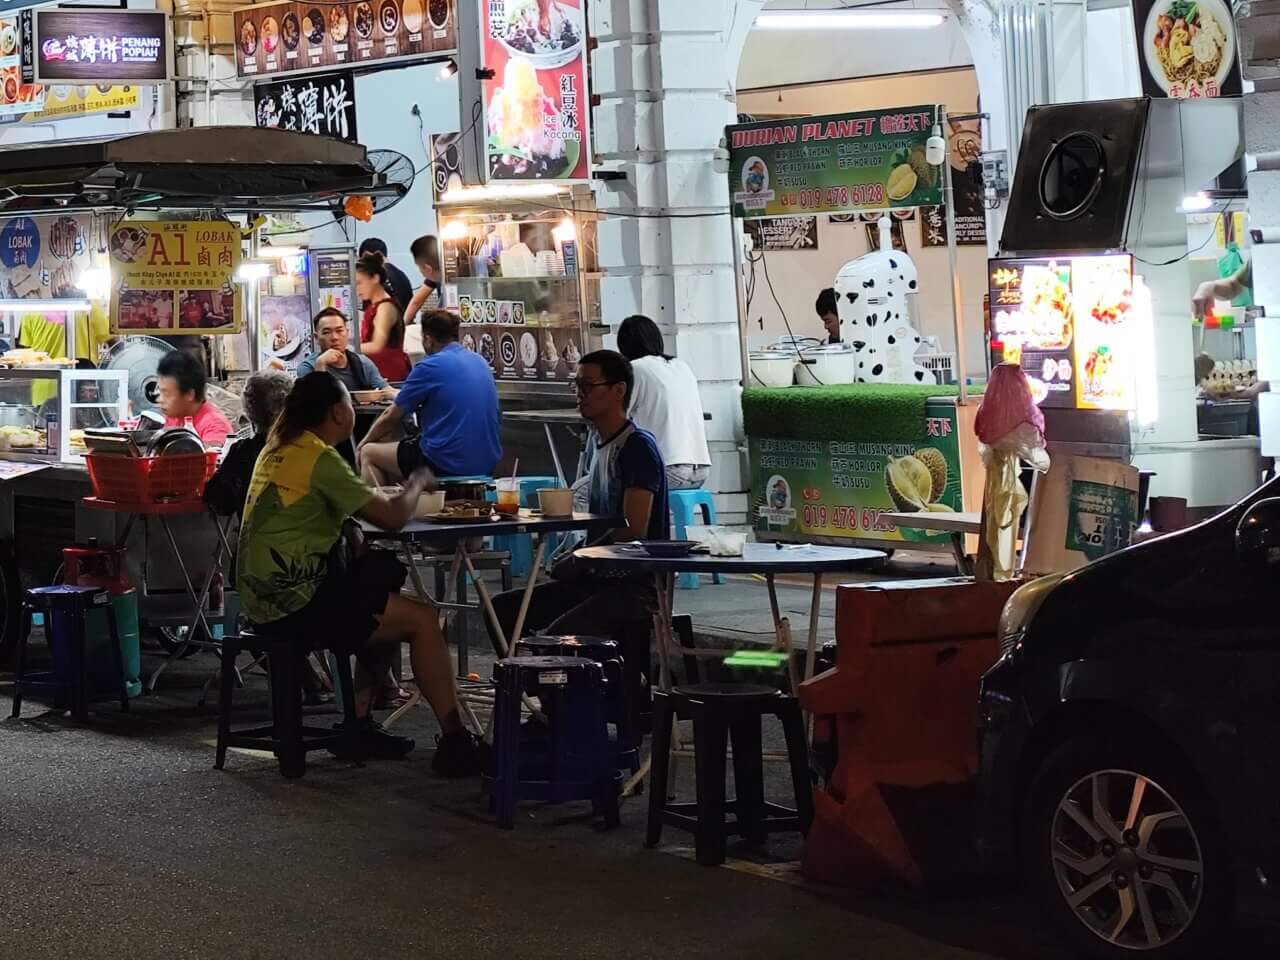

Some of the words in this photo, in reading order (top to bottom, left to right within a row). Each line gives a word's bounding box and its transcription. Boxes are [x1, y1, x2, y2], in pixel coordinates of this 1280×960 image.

[122, 38, 160, 47] PENANG
[122, 48, 158, 57] POPIAH
[543, 114, 557, 124] Ice
[543, 128, 581, 141] Kacang
[731, 124, 798, 149] DURIAN
[802, 117, 877, 142] PLANET
[863, 142, 893, 153] MUSANG
[894, 139, 912, 150] KING
[798, 188, 821, 209] 019
[825, 186, 849, 206] 478
[851, 184, 883, 205] 6128
[8, 235, 33, 249] LOBAK
[195, 231, 234, 242] LOBAK
[859, 442, 892, 456] MUSANG
[893, 443, 915, 457] KING
[849, 459, 865, 472] HOR
[866, 460, 881, 472] LOR
[849, 476, 871, 489] SUSU
[802, 504, 827, 528] 019
[831, 506, 857, 530] 478
